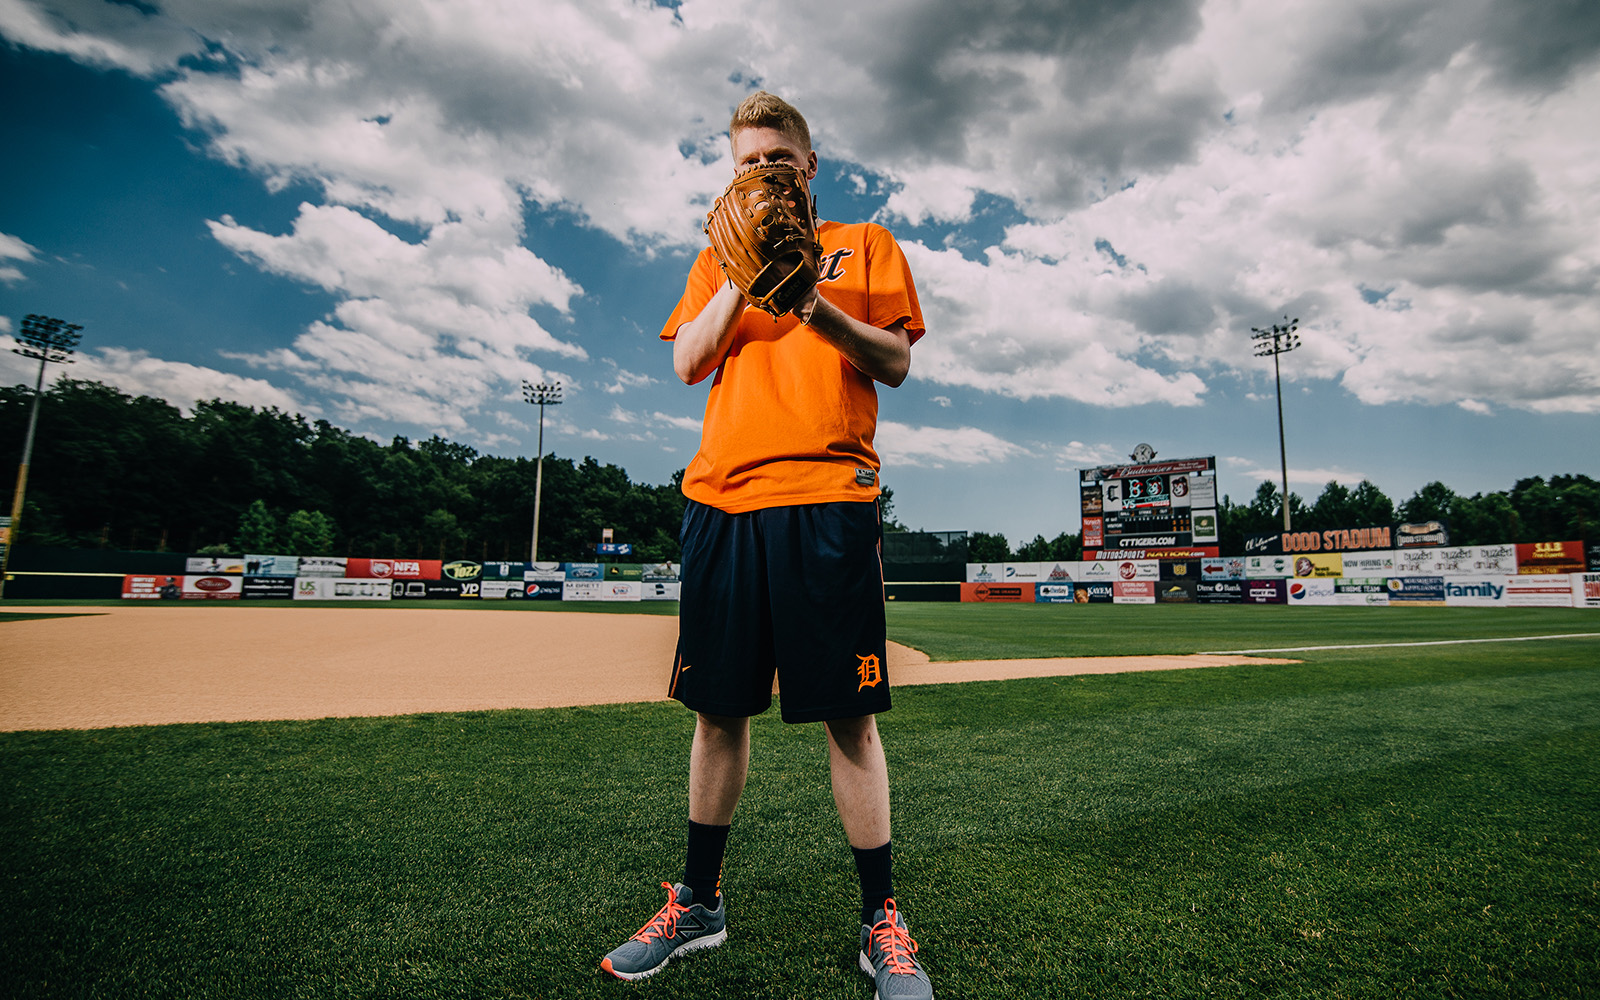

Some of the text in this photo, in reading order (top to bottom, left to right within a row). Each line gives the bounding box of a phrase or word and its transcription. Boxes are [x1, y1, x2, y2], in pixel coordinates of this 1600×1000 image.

[818, 247, 854, 284] it
[1120, 465, 1172, 477] Budweiser
[1122, 500, 1136, 509] VS
[1119, 536, 1176, 547] CTTIGERS.COM
[1245, 535, 1278, 551] Welcome
[1282, 526, 1391, 552] DODD STADIUM
[394, 562, 420, 572] NFA
[1343, 560, 1358, 568] NOW
[1359, 559, 1382, 567] HIRING
[454, 565, 482, 579] 107.7
[576, 569, 592, 577] Ford
[461, 583, 479, 595] yp
[1087, 587, 1113, 597] KAYEM
[1445, 582, 1503, 600] family
[856, 654, 883, 692] D
